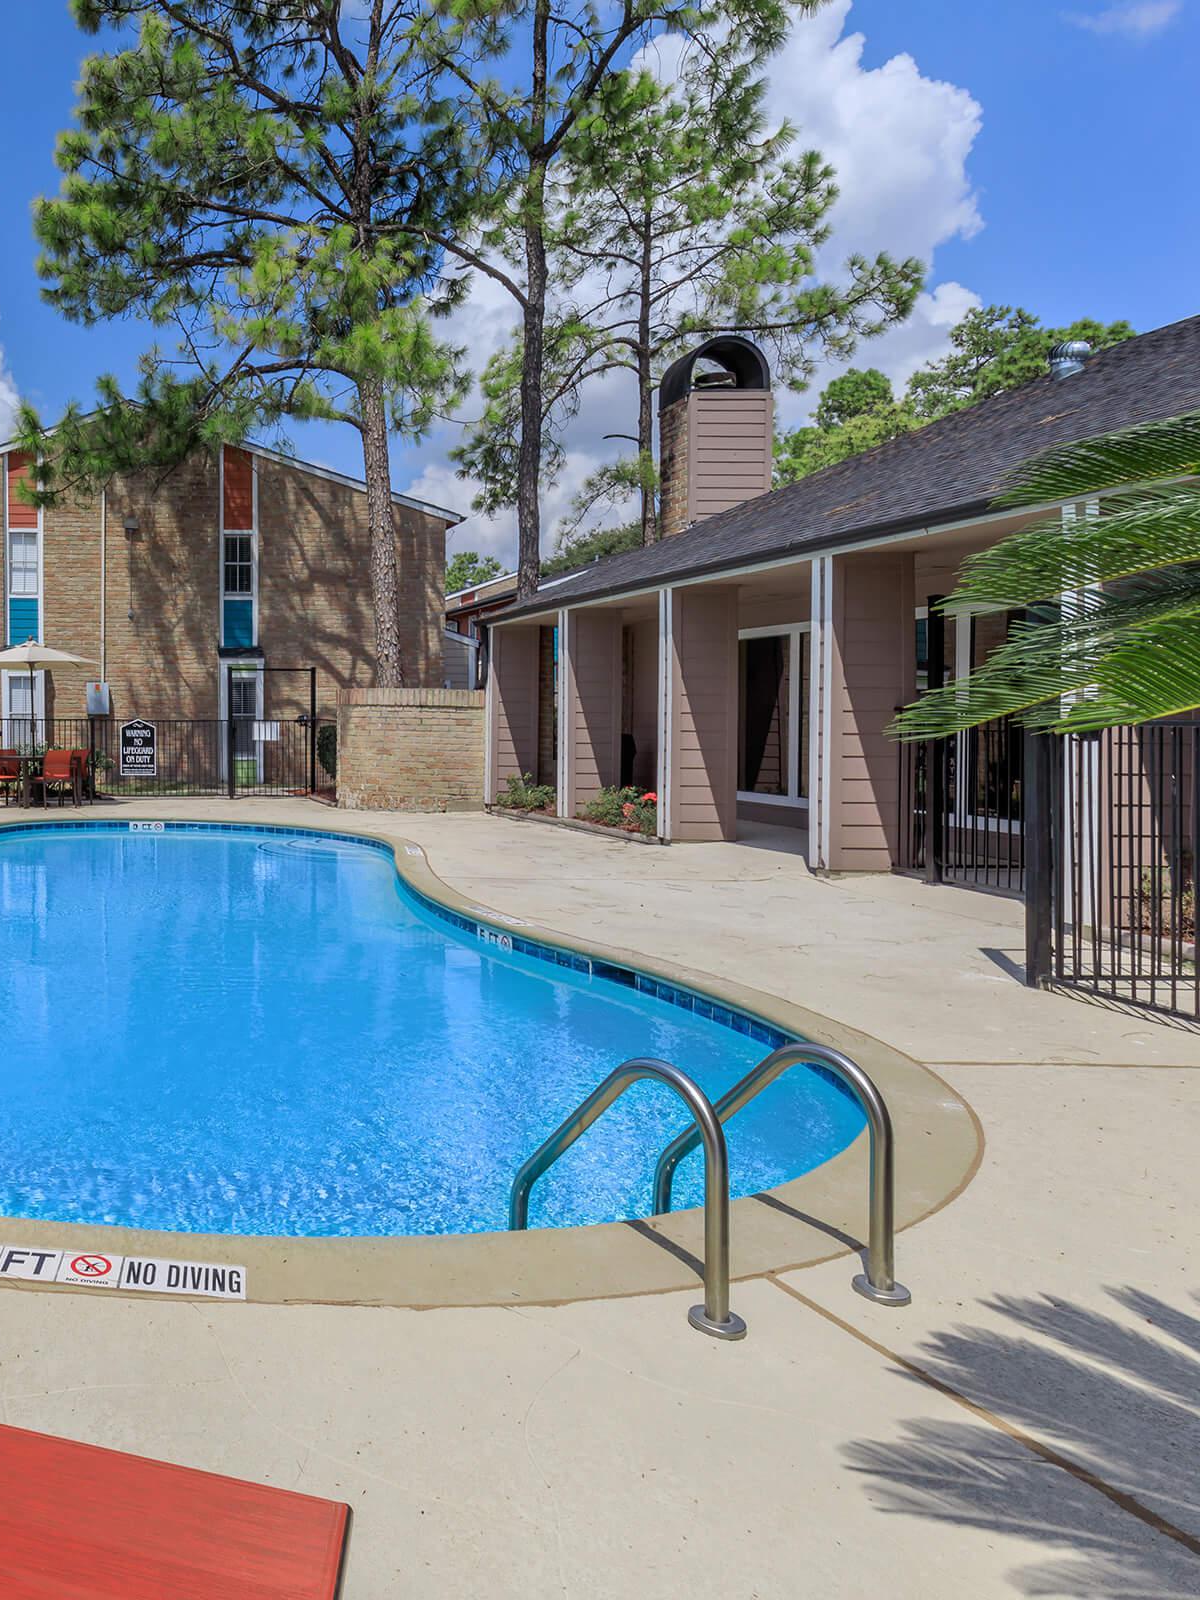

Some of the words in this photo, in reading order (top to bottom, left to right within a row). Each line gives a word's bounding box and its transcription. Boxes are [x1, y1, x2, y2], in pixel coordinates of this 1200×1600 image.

[133, 738, 143, 746] NO
[126, 755, 135, 763] ON
[136, 755, 151, 763] DUTY
[0, 1250, 56, 1275] FT
[126, 1261, 156, 1285] NO
[166, 1264, 241, 1294] DIVING
